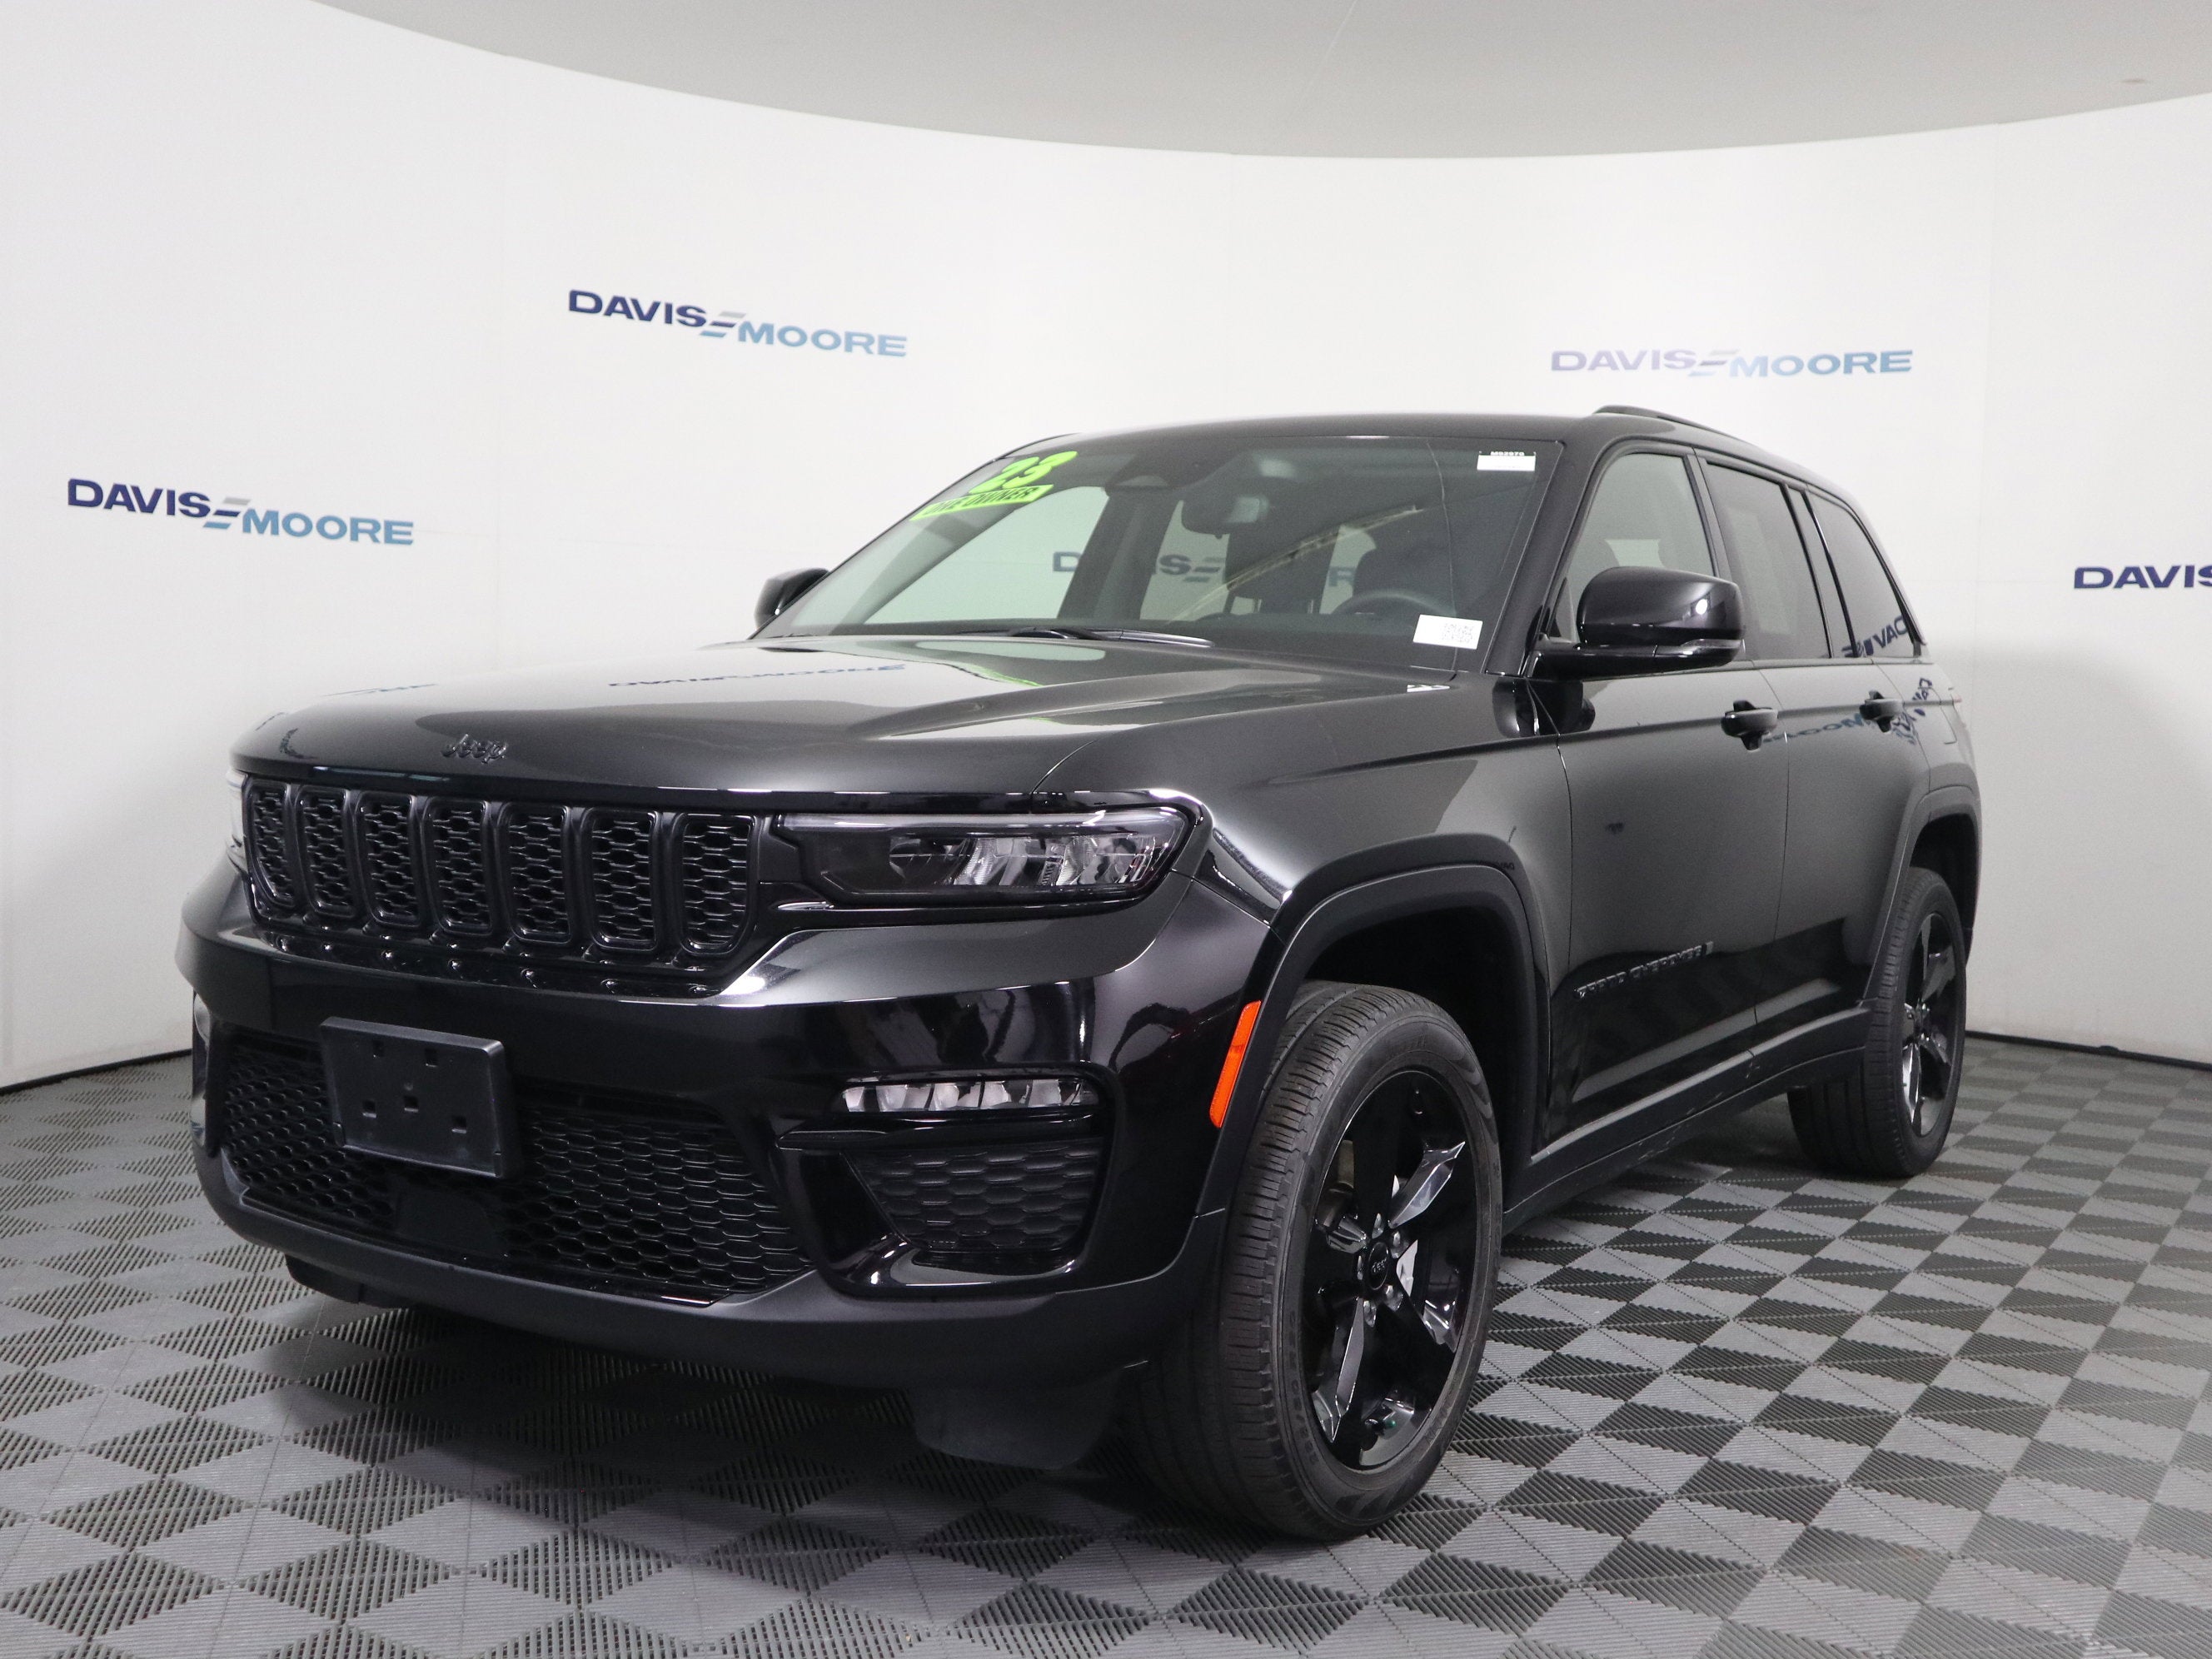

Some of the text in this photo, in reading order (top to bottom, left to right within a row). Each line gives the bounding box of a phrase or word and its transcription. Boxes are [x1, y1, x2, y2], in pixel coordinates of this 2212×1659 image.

[568, 288, 907, 357] DAVIS MOORE
[1551, 349, 1914, 378] DAVIS MOORE
[67, 477, 414, 546] DAVIS MOORE
[442, 733, 508, 764] Jeep
